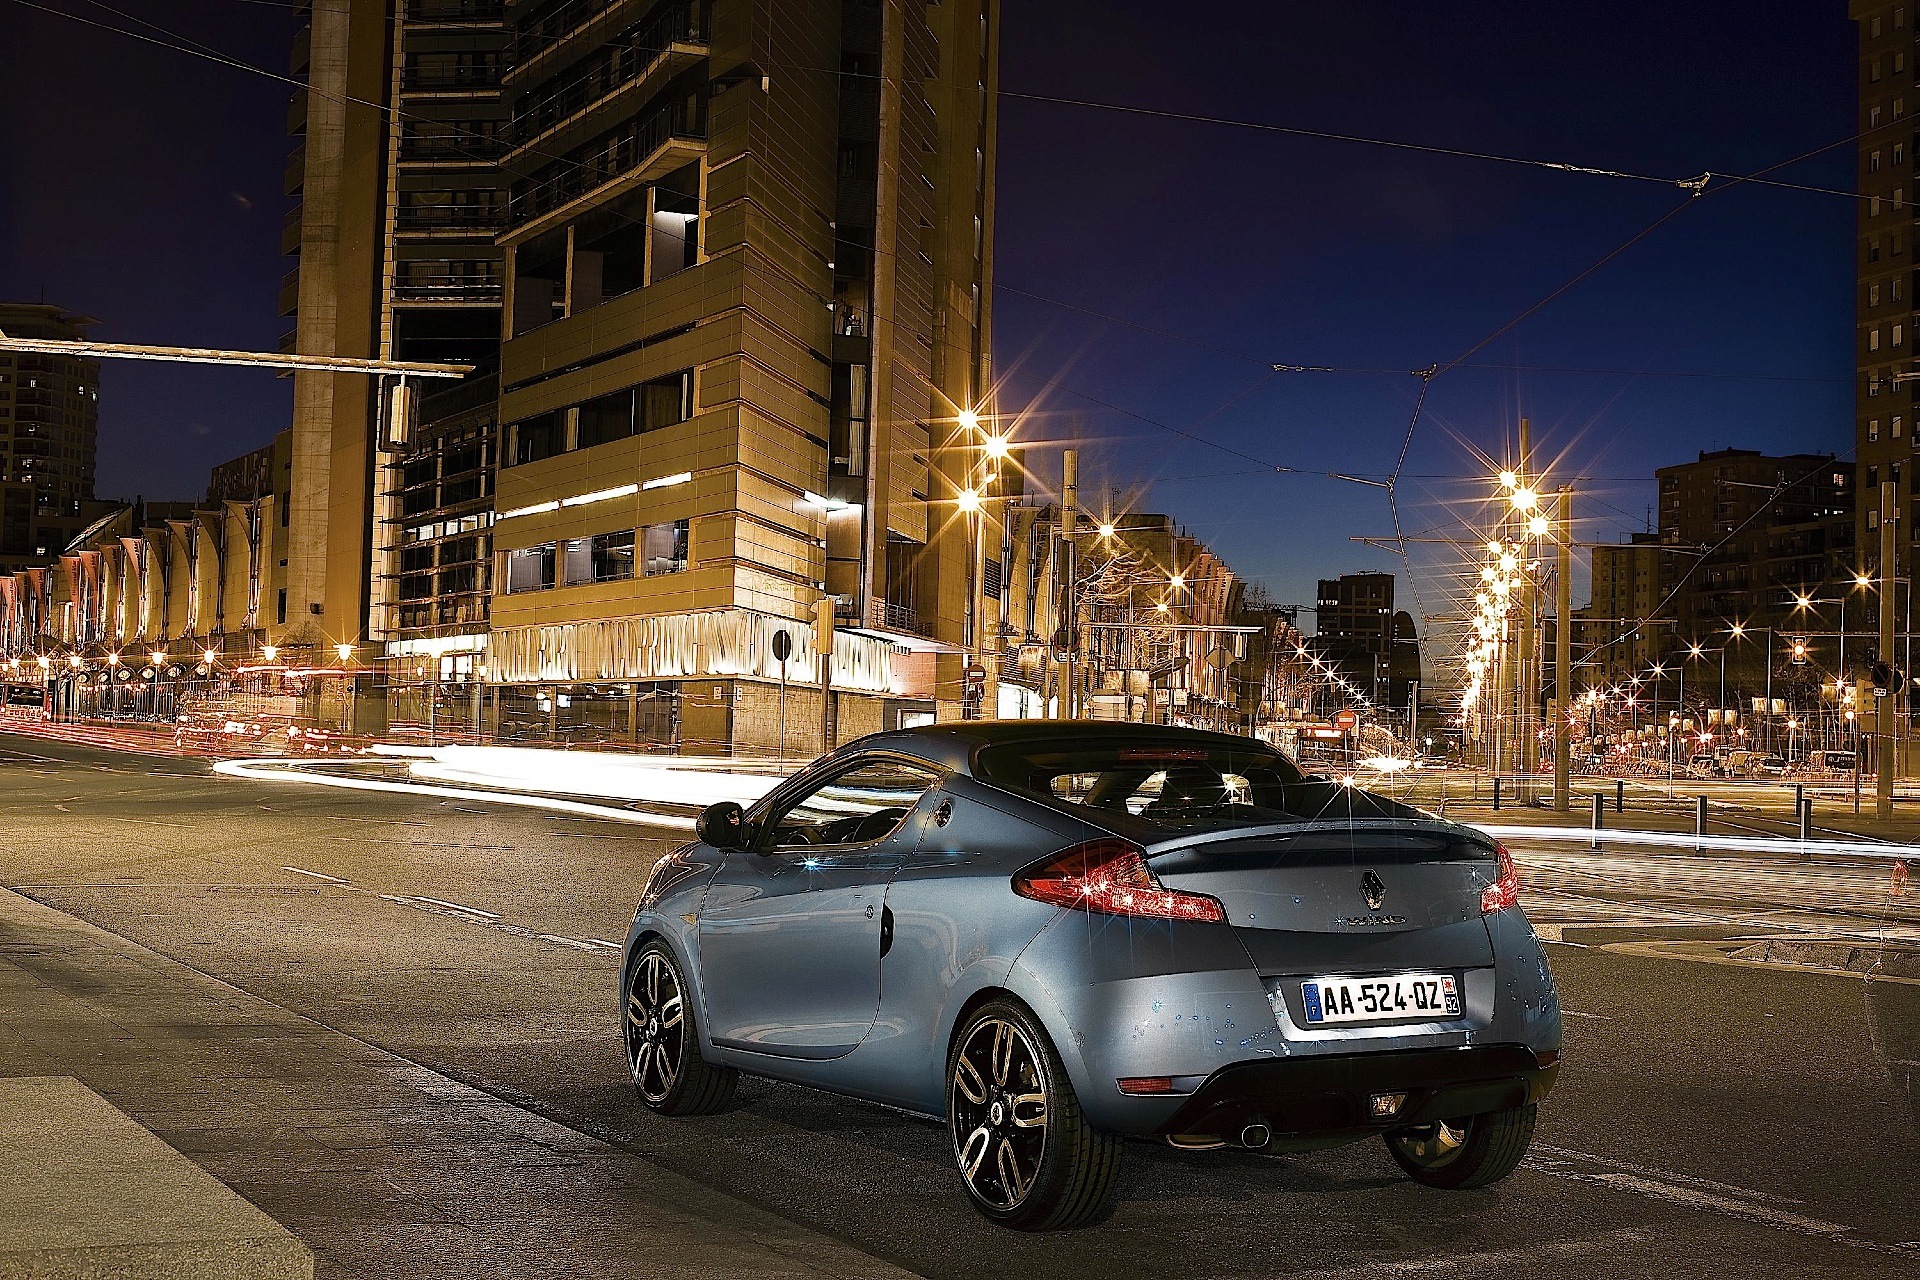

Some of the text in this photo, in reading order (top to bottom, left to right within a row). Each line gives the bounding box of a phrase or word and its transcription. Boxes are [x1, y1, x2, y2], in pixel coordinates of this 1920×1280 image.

[1324, 982, 1442, 1016] AA-524-QZ
[1446, 997, 1458, 1010] 92
[1310, 1006, 1316, 1016] F
